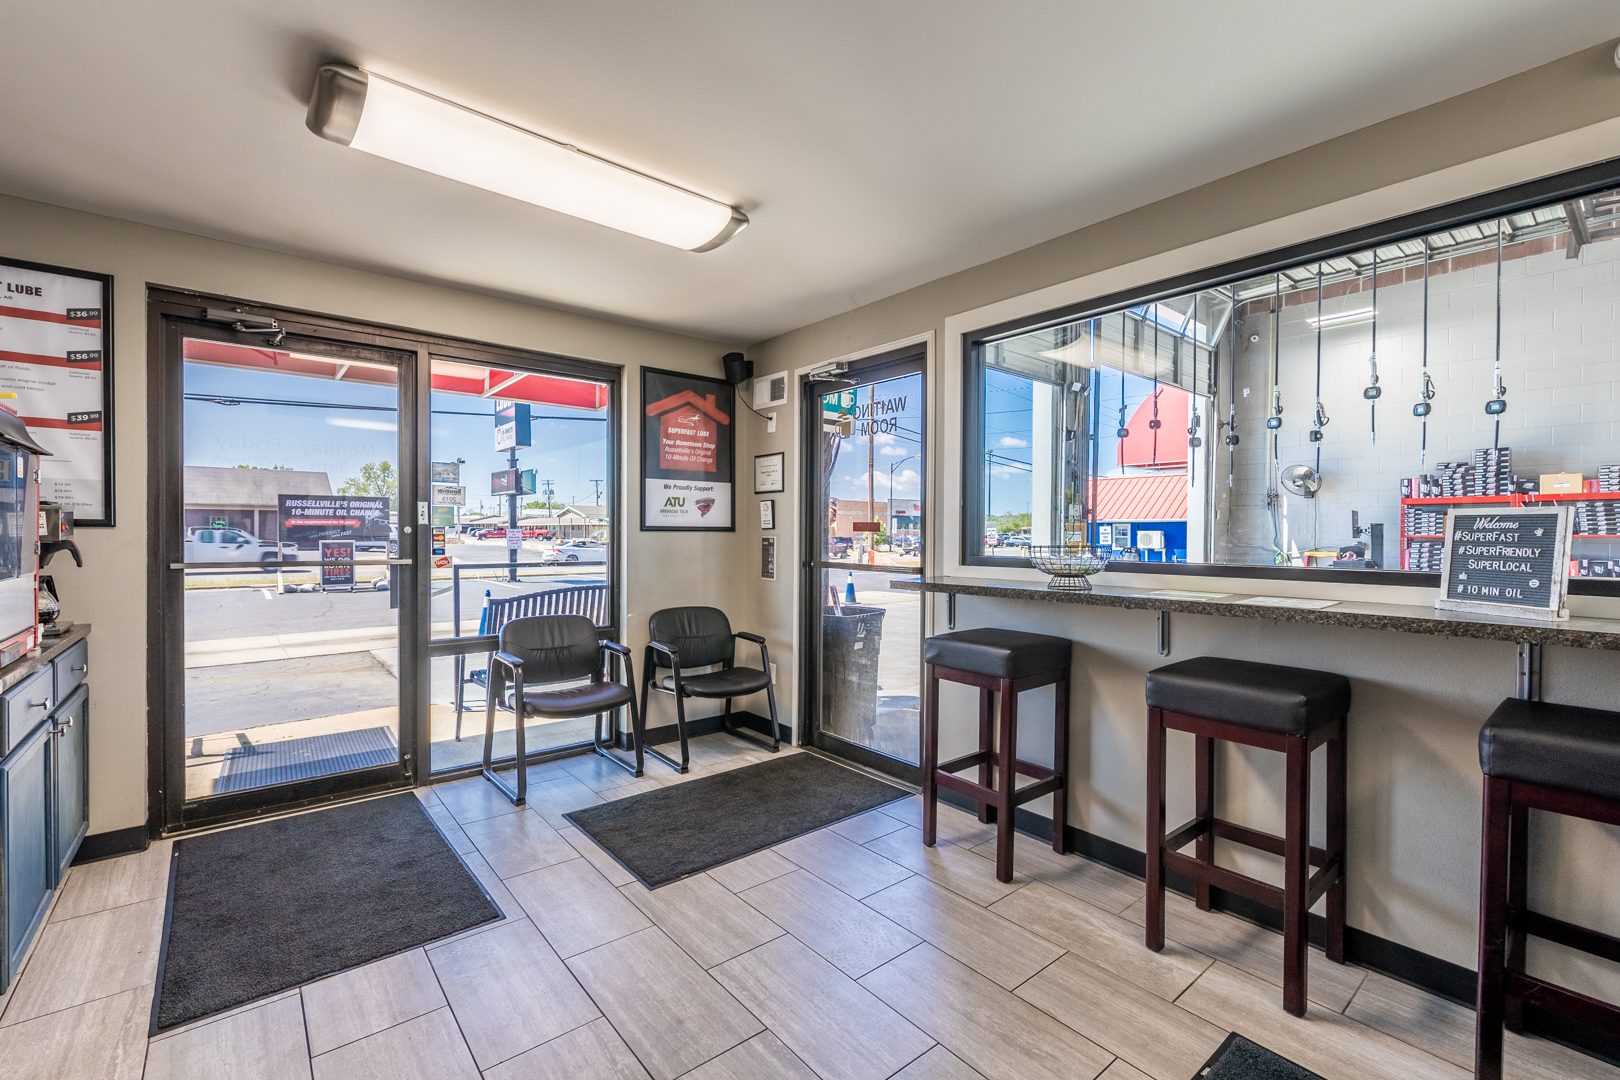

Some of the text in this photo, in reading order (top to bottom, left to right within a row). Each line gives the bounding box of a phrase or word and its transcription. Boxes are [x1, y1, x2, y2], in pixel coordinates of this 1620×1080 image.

[7, 282, 43, 297] LUBE
[70, 310, 98, 318] $36.99
[668, 427, 697, 436] SUPERFAST
[664, 496, 685, 507] ATU
[1474, 516, 1519, 529] Welcome
[1454, 531, 1519, 542] #SUPERFAST
[324, 548, 350, 557] YES!
[1459, 545, 1541, 557] #SUPERFRIENDLY
[1468, 586, 1478, 594] 10
[1482, 587, 1499, 596] MIN
[1505, 589, 1523, 598] OIL
